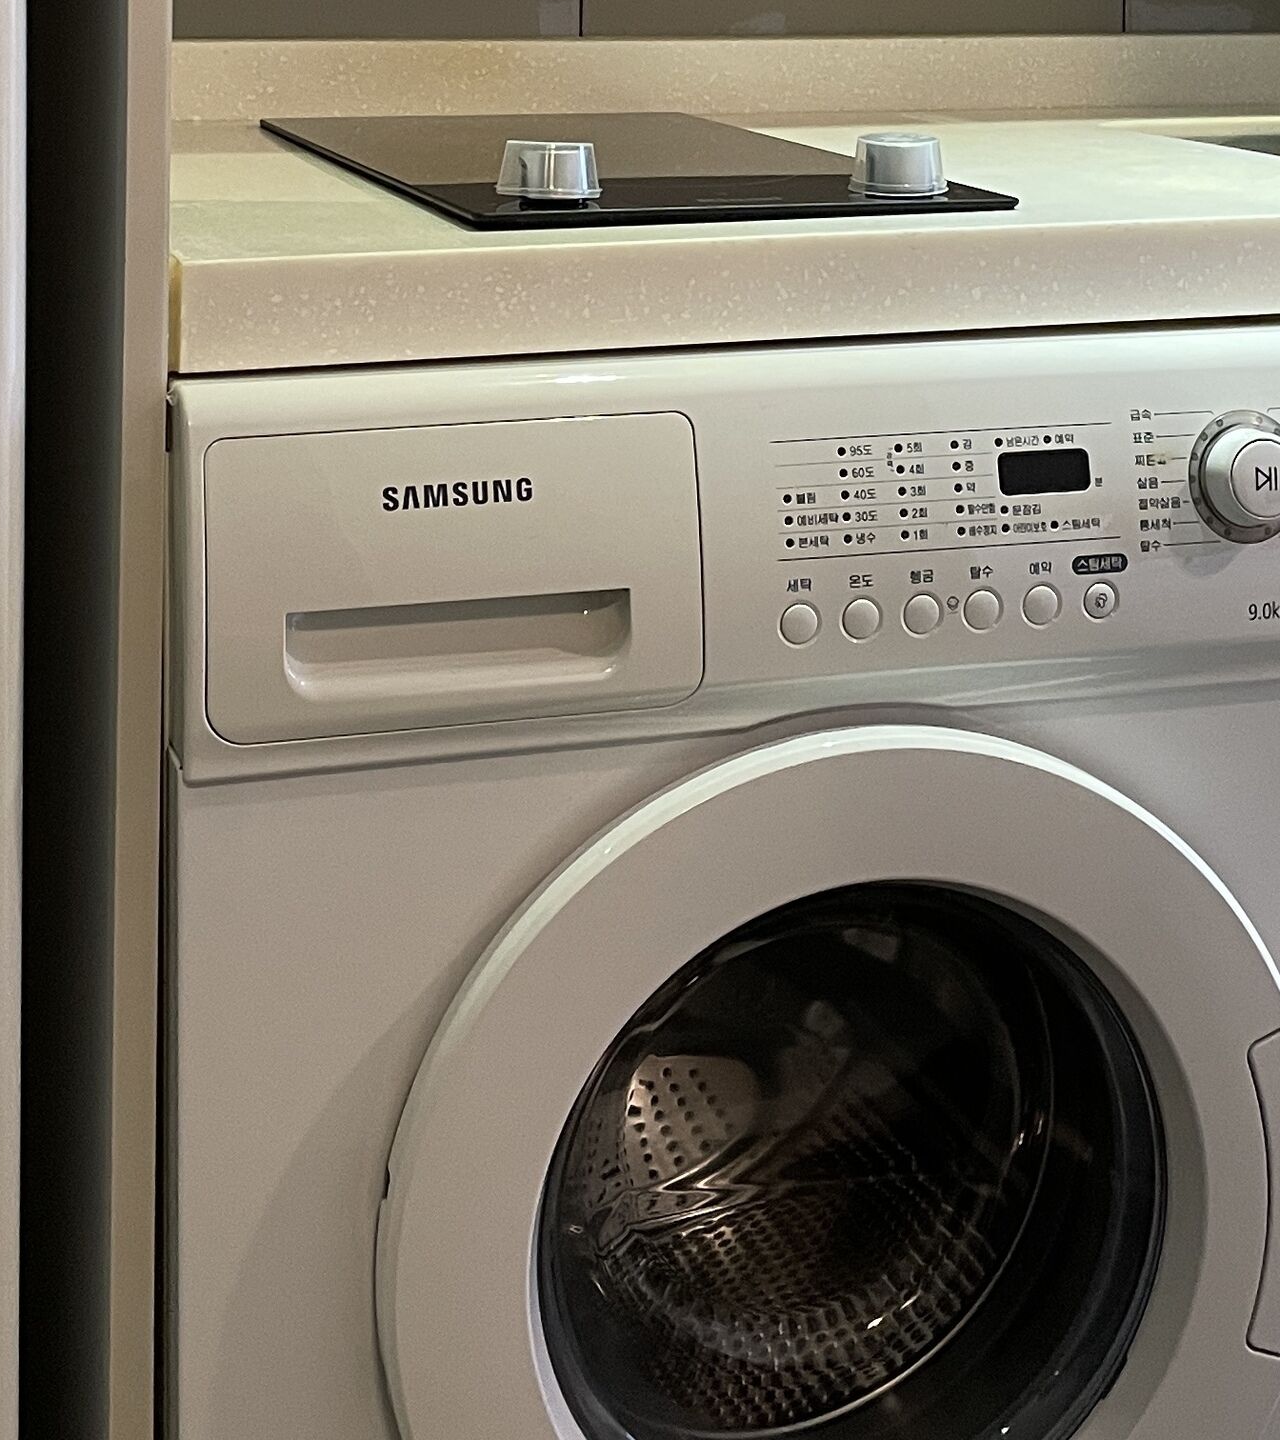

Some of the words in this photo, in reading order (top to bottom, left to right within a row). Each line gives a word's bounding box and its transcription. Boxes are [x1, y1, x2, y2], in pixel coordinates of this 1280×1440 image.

[1130, 409, 1152, 422] 급속
[1054, 433, 1074, 445] 예약
[1132, 432, 1154, 444] 표준
[849, 444, 873, 457] 95도
[852, 466, 875, 479] 60도
[382, 477, 533, 511] SAMSUNG
[853, 488, 876, 500] 40도
[966, 482, 976, 494] 약
[855, 510, 878, 522] 30도
[1012, 504, 1042, 516] 문잠김
[797, 513, 839, 526] 예비세탁
[1062, 517, 1101, 531] 스팀세탁
[799, 535, 830, 548] 본세탁
[856, 532, 876, 545] 냉수
[970, 565, 994, 580] 탈수
[1029, 561, 1052, 575] 예약
[849, 574, 874, 589] 온도
[909, 569, 935, 585] 헹굼
[786, 578, 813, 593] 세탁
